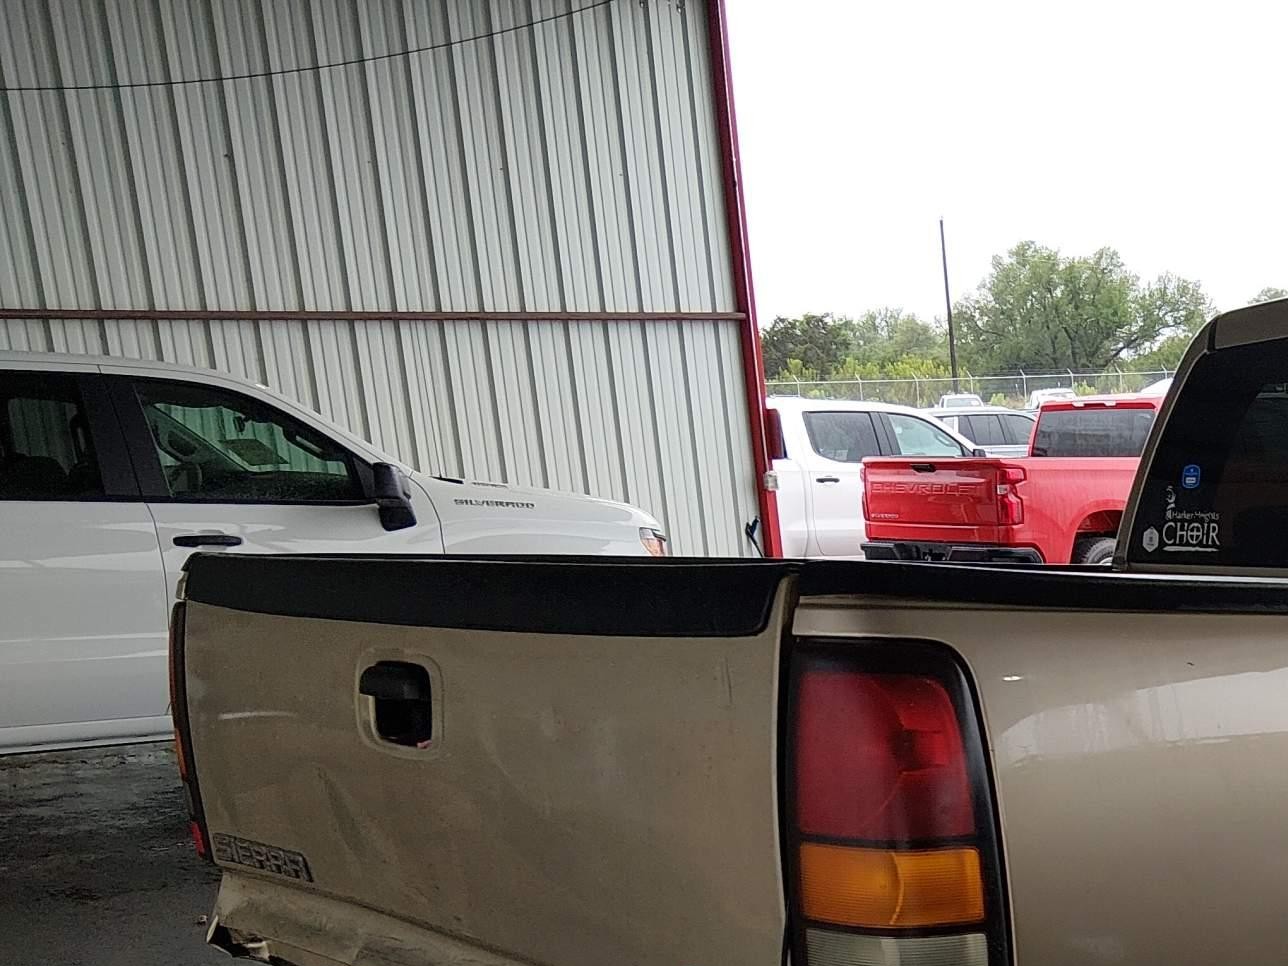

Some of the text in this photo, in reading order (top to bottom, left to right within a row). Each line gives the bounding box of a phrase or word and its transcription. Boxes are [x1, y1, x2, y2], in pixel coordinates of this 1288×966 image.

[870, 482, 984, 496] CHEVROLE
[454, 498, 535, 509] SILVERADO
[1162, 521, 1221, 545] CHOIR
[213, 833, 313, 882] SIERRA
